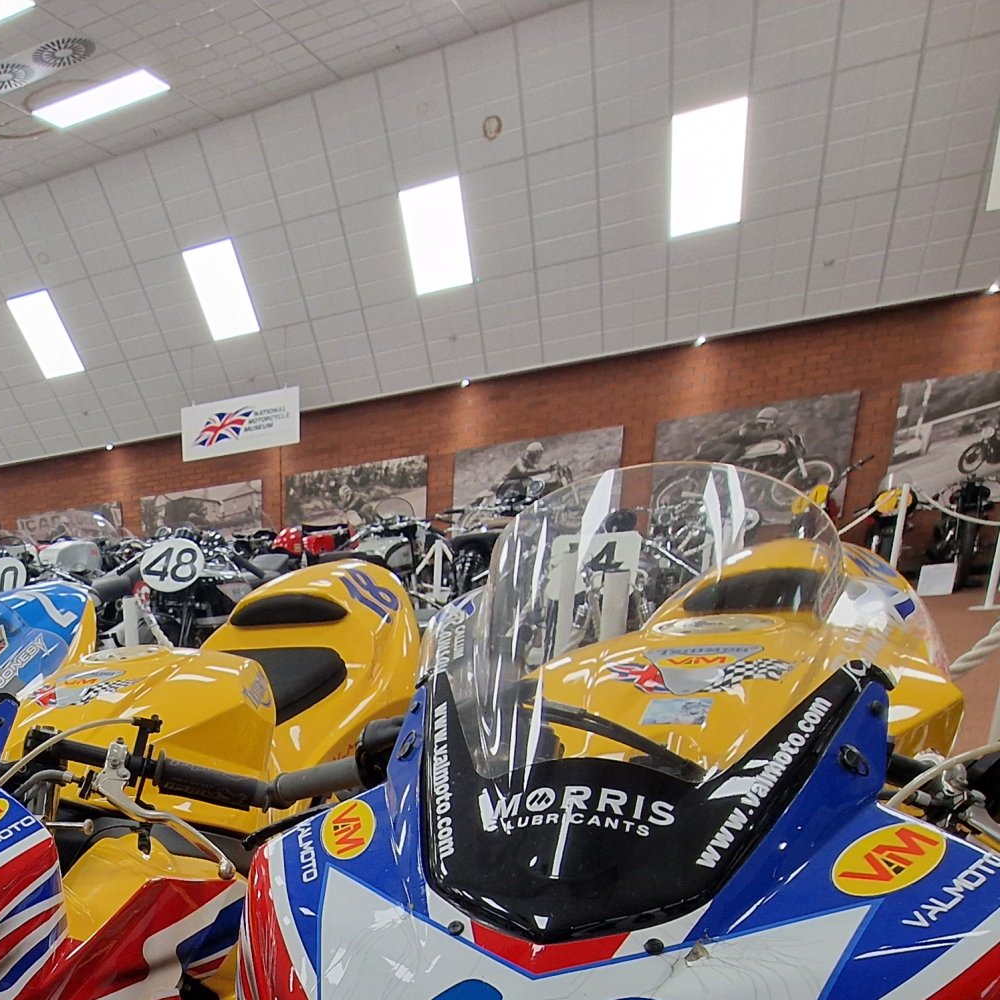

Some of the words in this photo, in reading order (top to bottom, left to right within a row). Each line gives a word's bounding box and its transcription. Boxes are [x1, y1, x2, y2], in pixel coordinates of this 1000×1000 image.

[142, 547, 198, 583] 48
[339, 568, 400, 623] 18
[433, 700, 455, 862] www.valmoto.com
[488, 785, 676, 827] MORRIS
[695, 696, 833, 869] www.valmoto.com
[295, 816, 318, 883] VALMOTO
